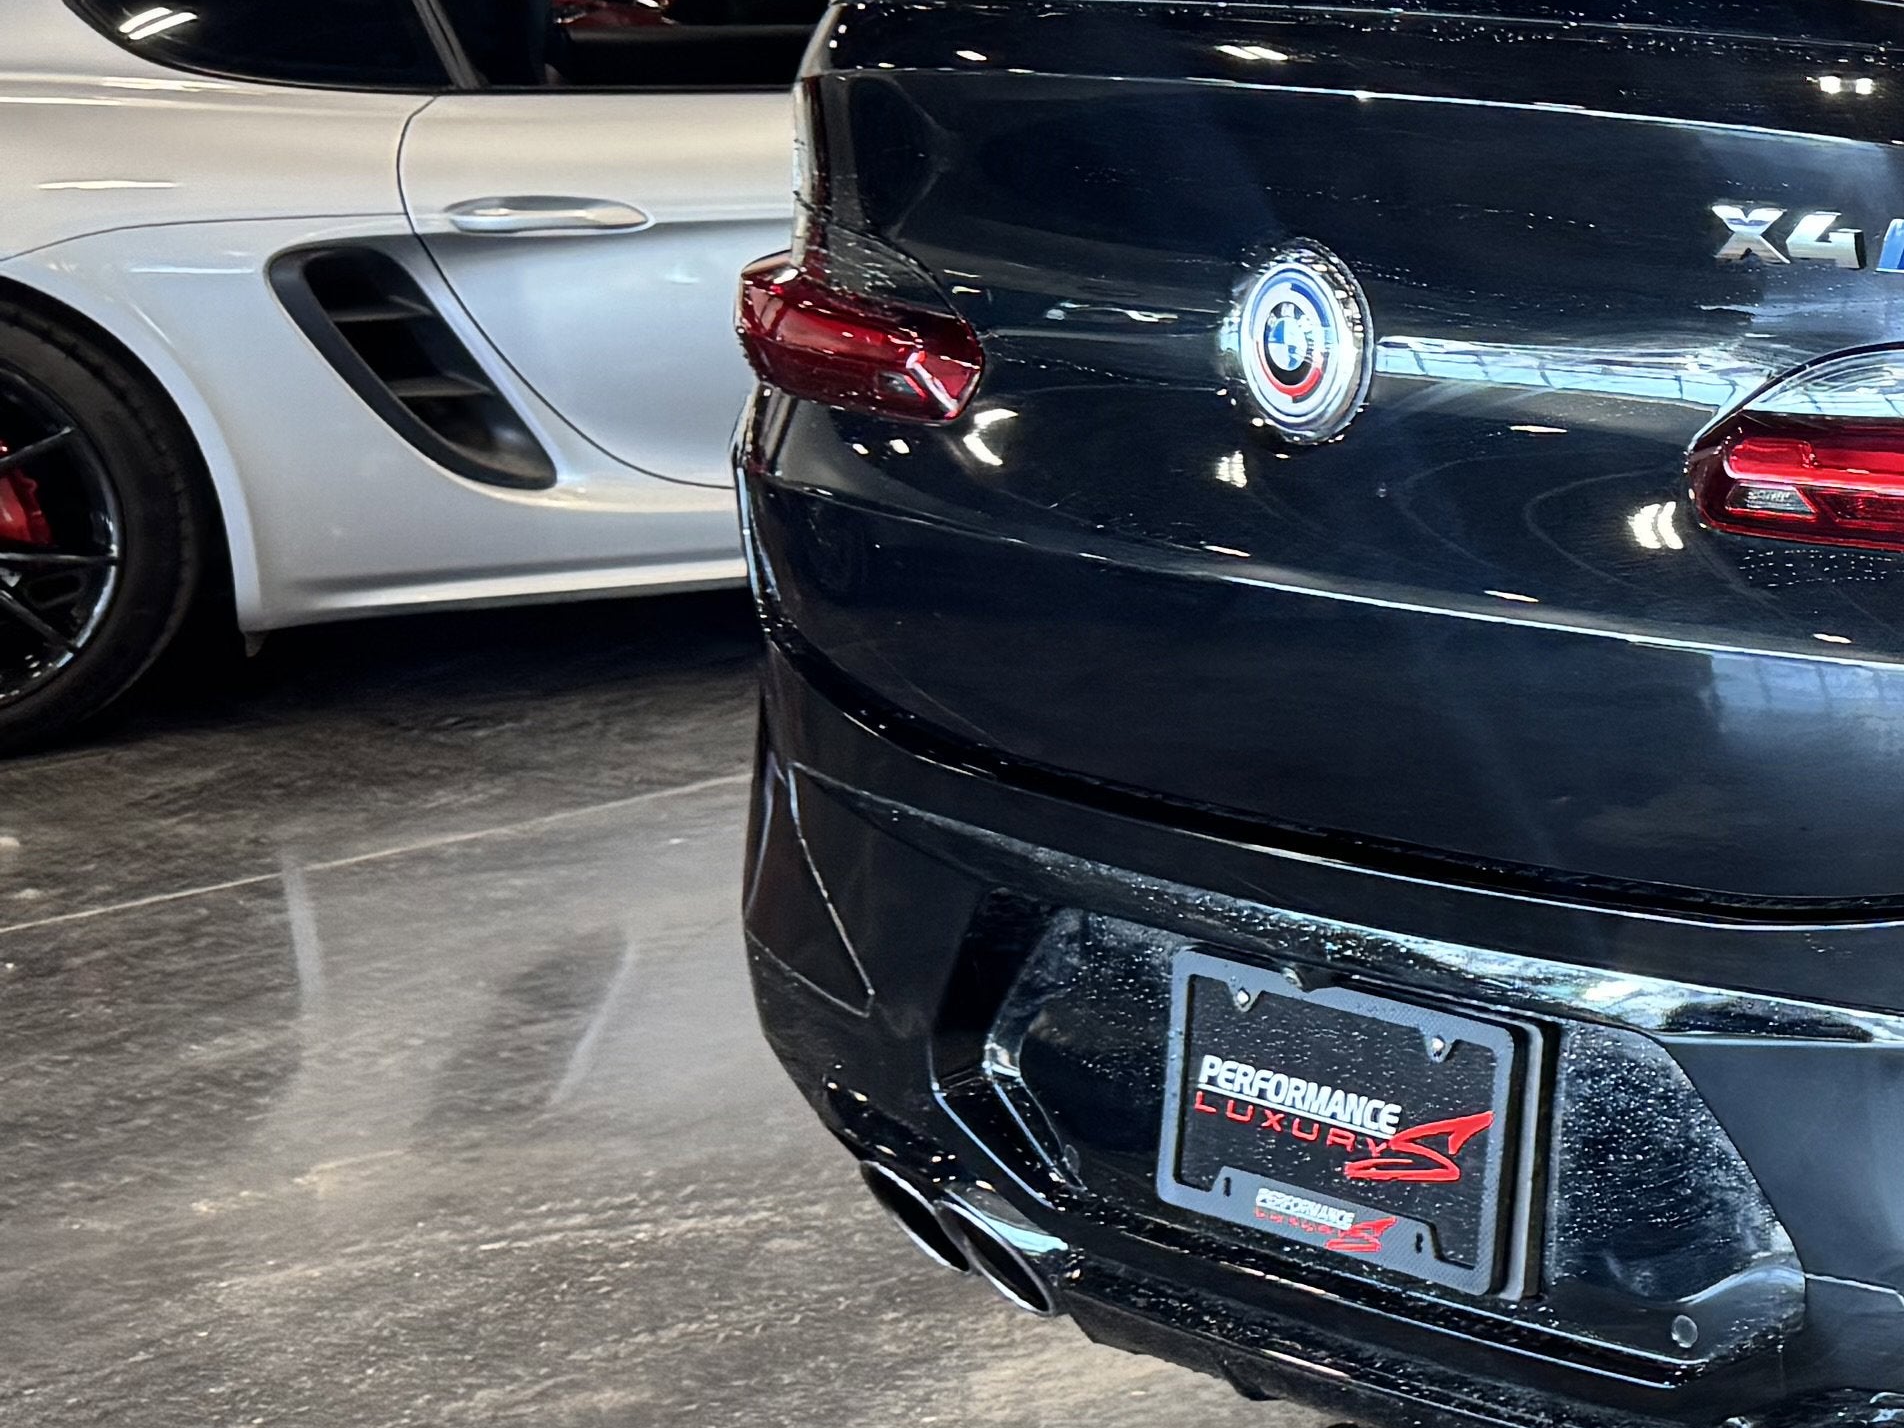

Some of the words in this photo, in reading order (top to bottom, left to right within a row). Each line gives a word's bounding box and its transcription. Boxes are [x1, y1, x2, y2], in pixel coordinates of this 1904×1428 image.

[1711, 203, 1865, 269] X4
[1194, 1090, 1390, 1158] LUXURY
[1198, 1054, 1402, 1135] PERFORMANCE
